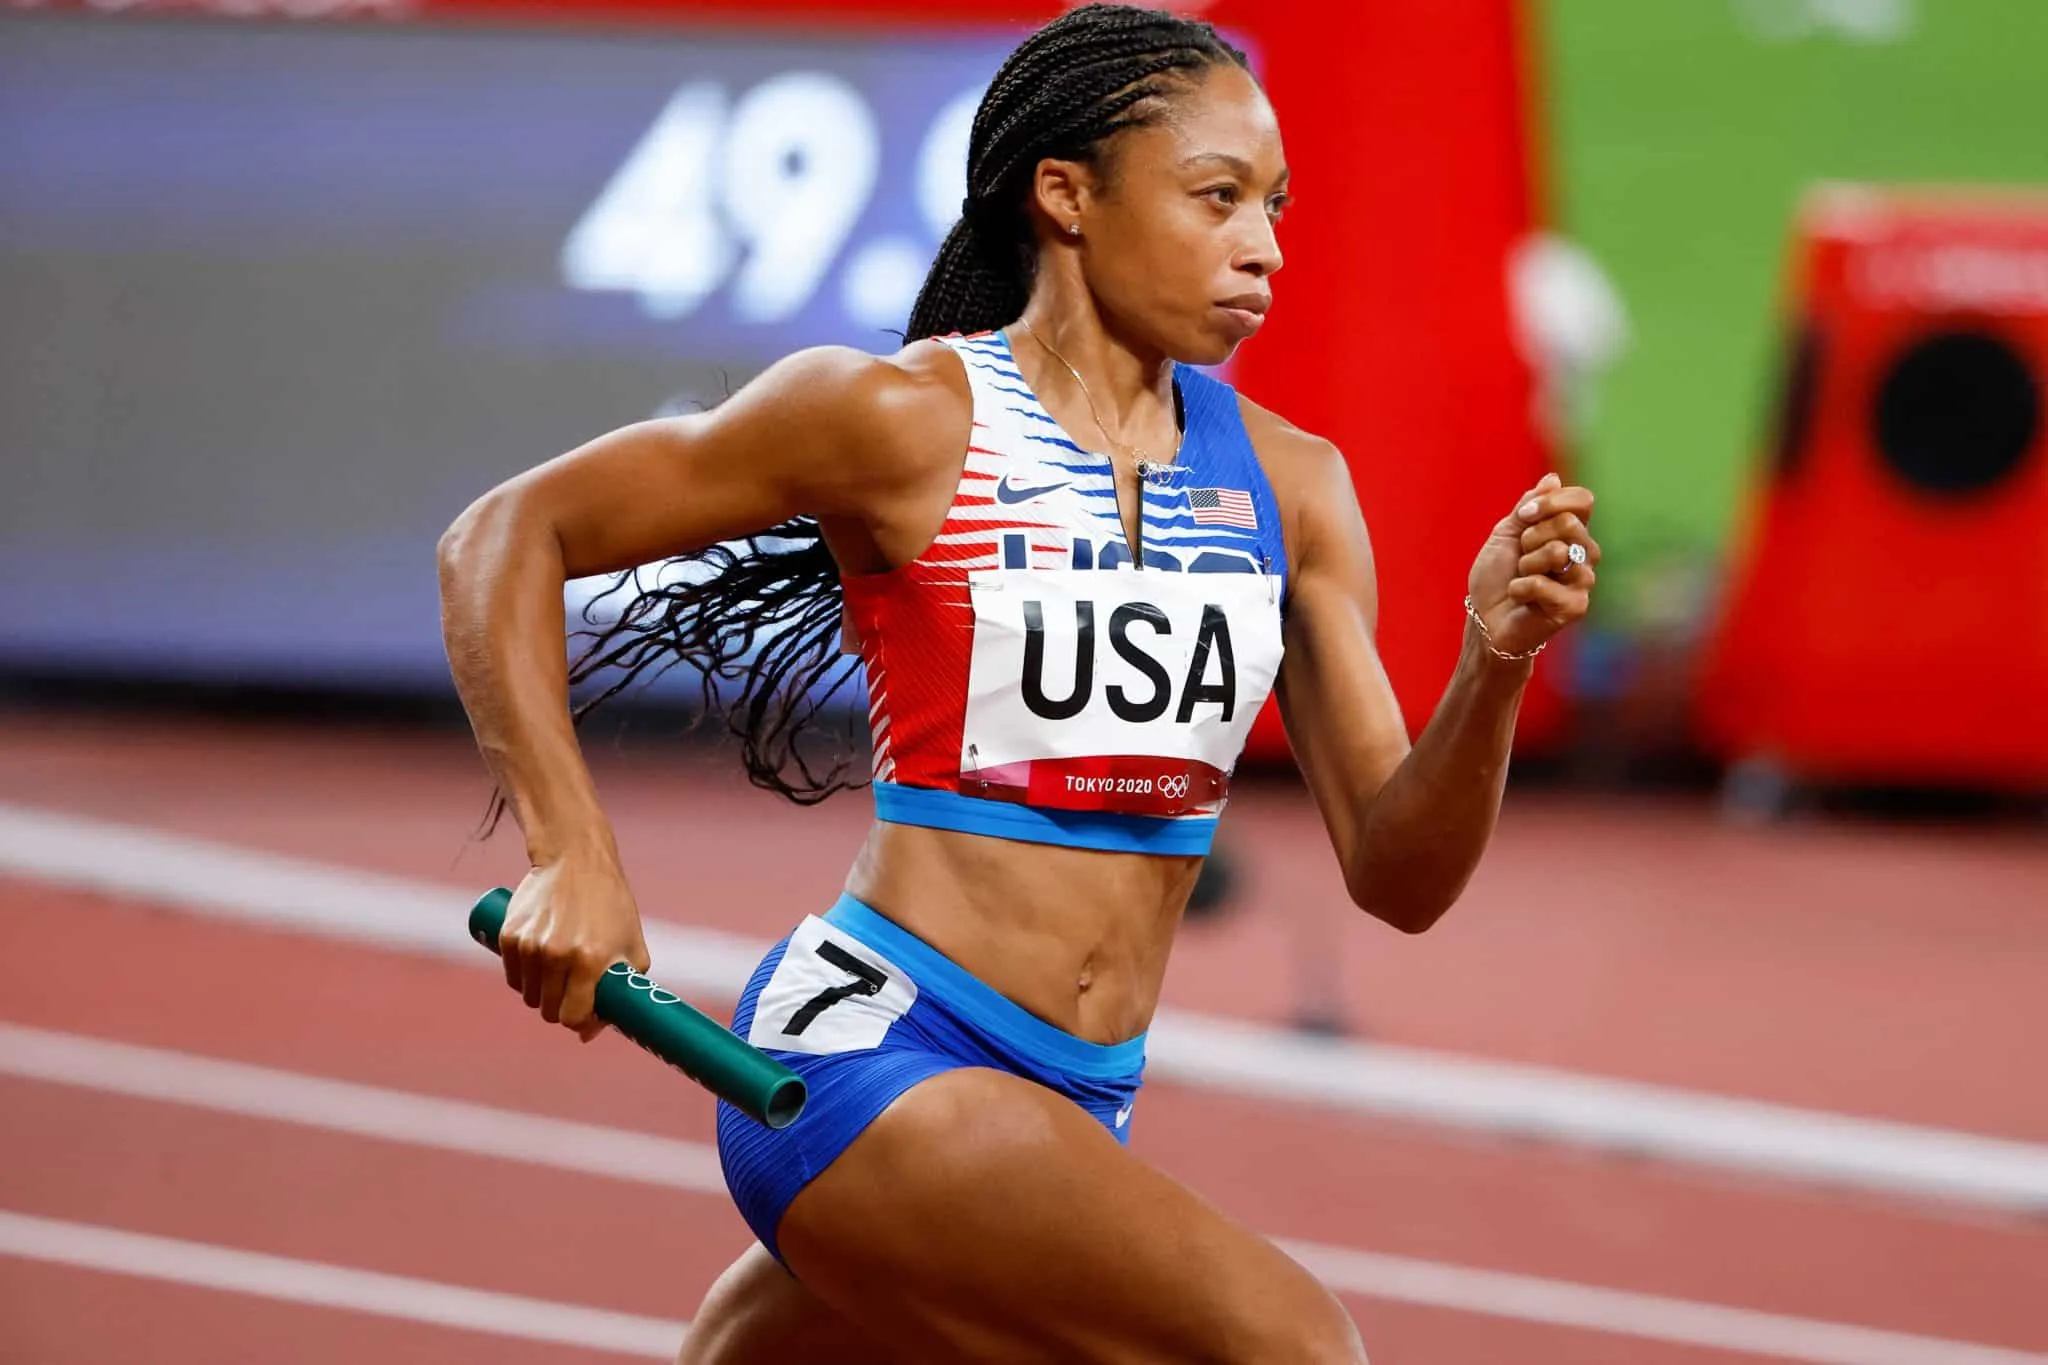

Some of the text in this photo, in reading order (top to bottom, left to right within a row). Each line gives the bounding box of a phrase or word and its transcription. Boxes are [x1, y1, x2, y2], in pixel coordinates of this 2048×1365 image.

[1021, 600, 1236, 724] USA
[1065, 775, 1153, 793] TOKYO 2020
[781, 939, 888, 1036] 7
